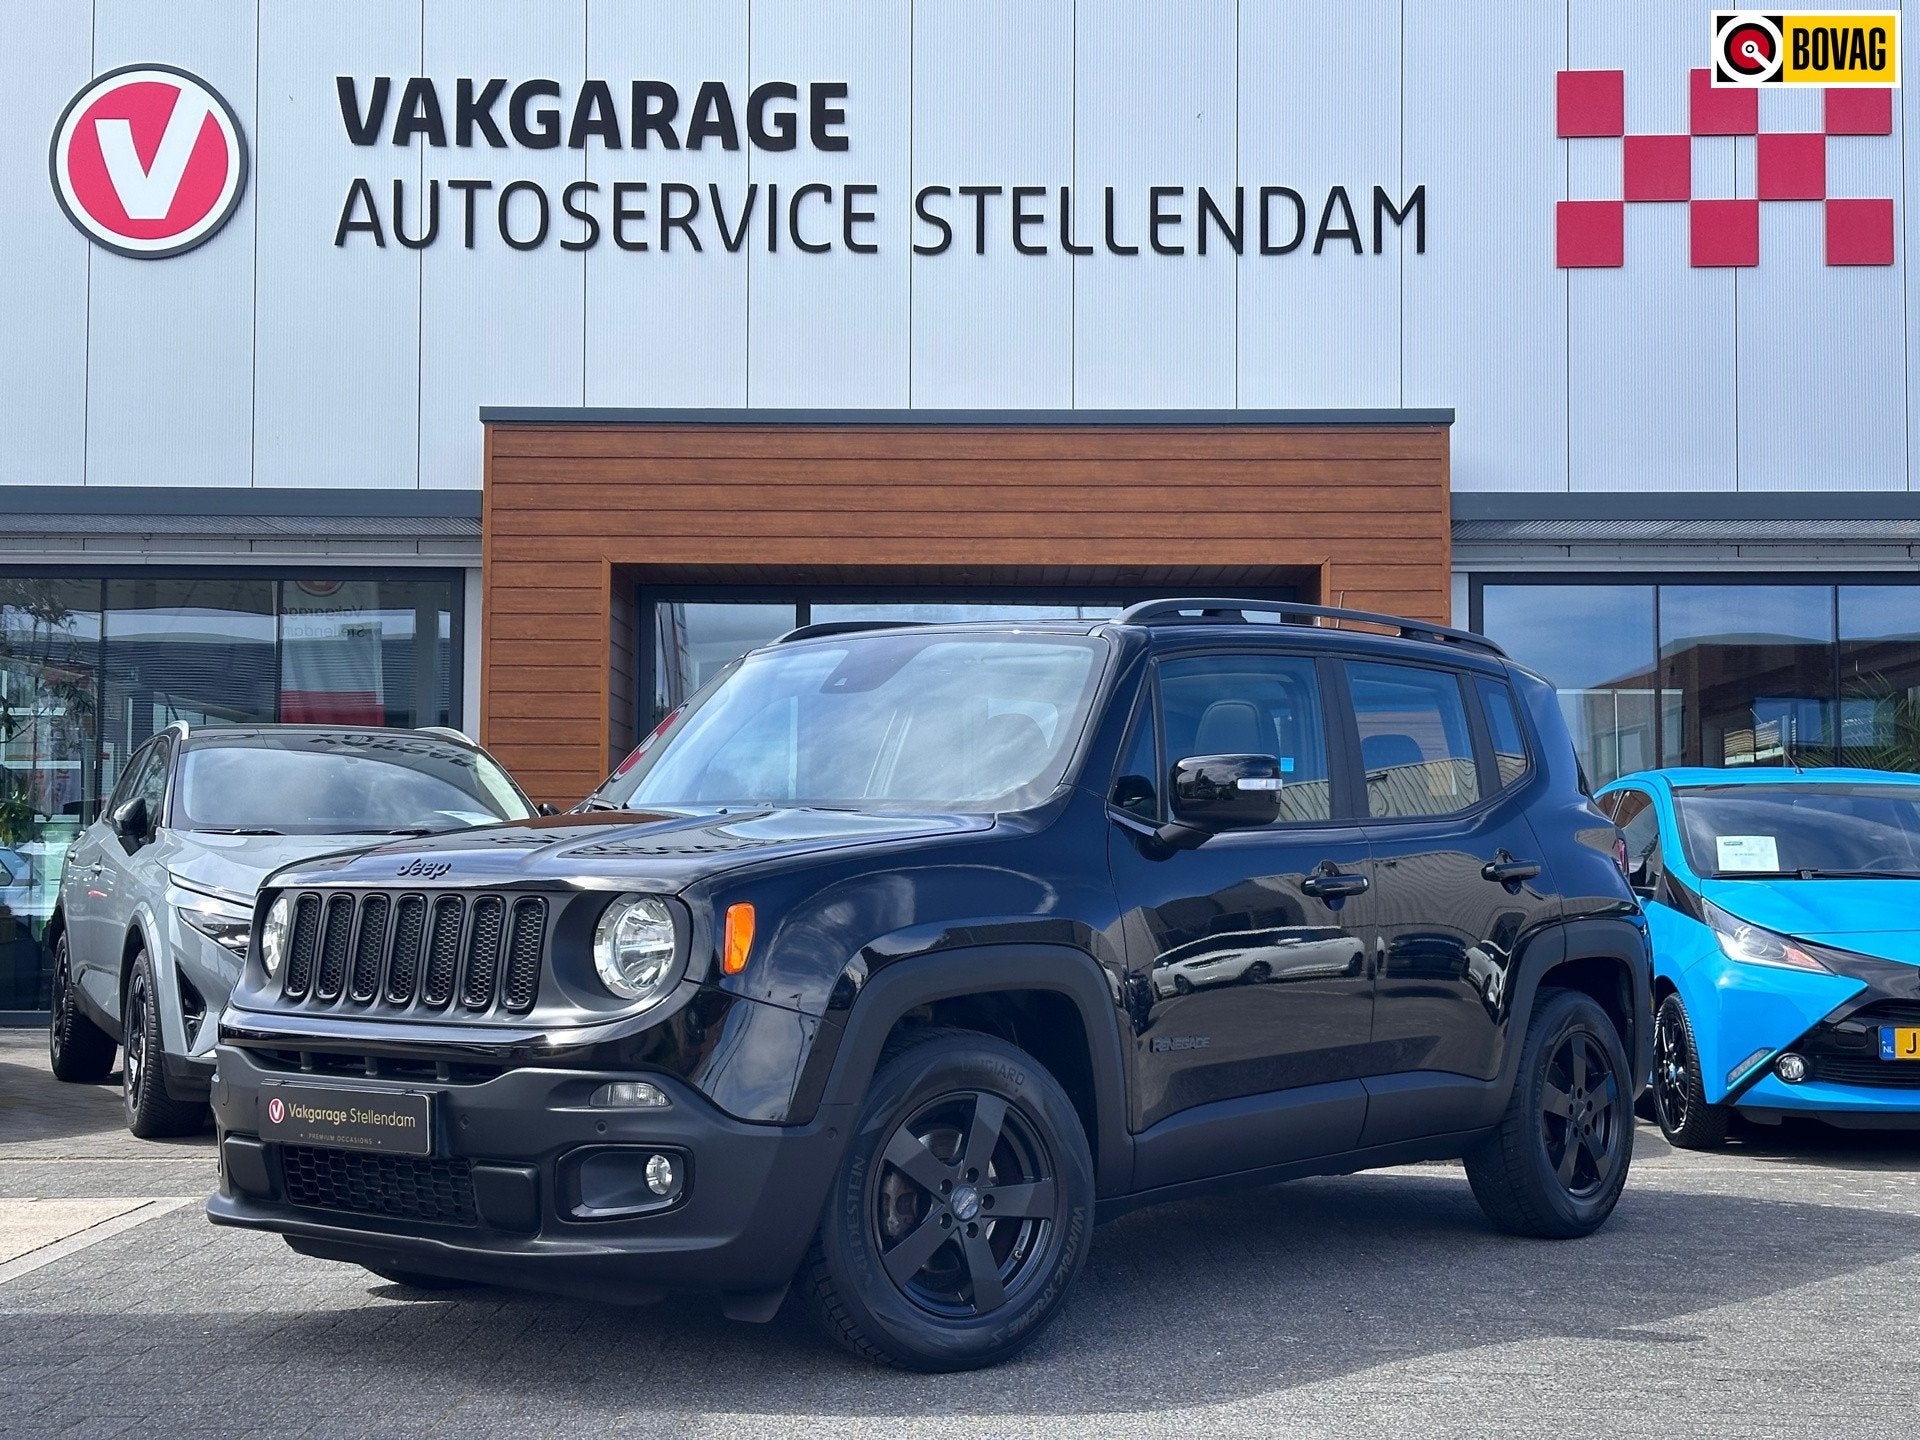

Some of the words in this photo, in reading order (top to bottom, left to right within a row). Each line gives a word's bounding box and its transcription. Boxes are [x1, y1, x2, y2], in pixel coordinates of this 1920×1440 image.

[336, 76, 849, 151] VAKGARAGE
[335, 178, 878, 253] AUTOSERVICE
[913, 184, 1427, 256] STELLENDAM
[396, 858, 452, 880] Jeep
[1152, 1036, 1211, 1052] RENEGADE
[1882, 1045, 1895, 1054] NL
[288, 1102, 347, 1126] Vakgarage
[350, 1107, 416, 1128] Stellendam
[308, 1132, 335, 1143] PREMIUM
[336, 1134, 373, 1145] OCCASIONS
